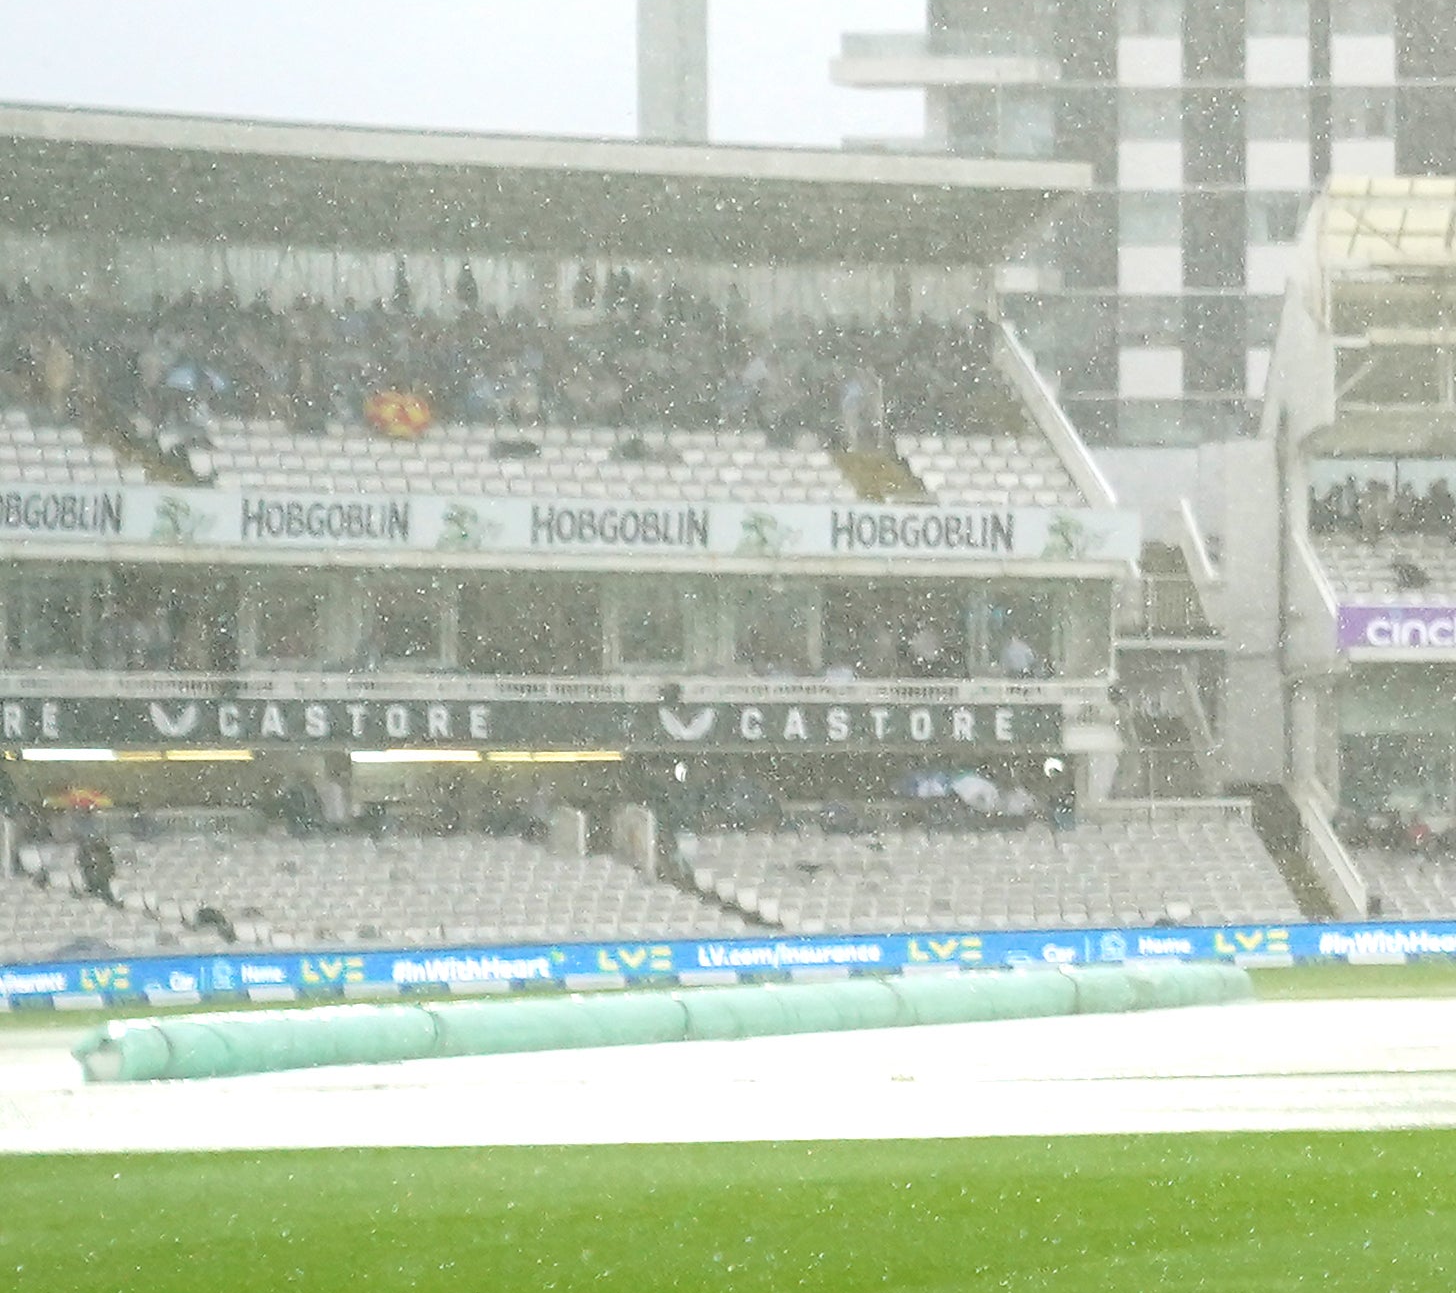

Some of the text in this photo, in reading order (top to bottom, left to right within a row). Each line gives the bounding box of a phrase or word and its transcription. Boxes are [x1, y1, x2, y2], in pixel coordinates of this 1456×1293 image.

[240, 496, 411, 543] HOBGOBLIN
[530, 503, 710, 549] HOBGOBLIN
[829, 509, 1015, 554] HOBGOBLIN
[218, 705, 492, 740] CASTORE
[739, 707, 1015, 743] CASTORE
